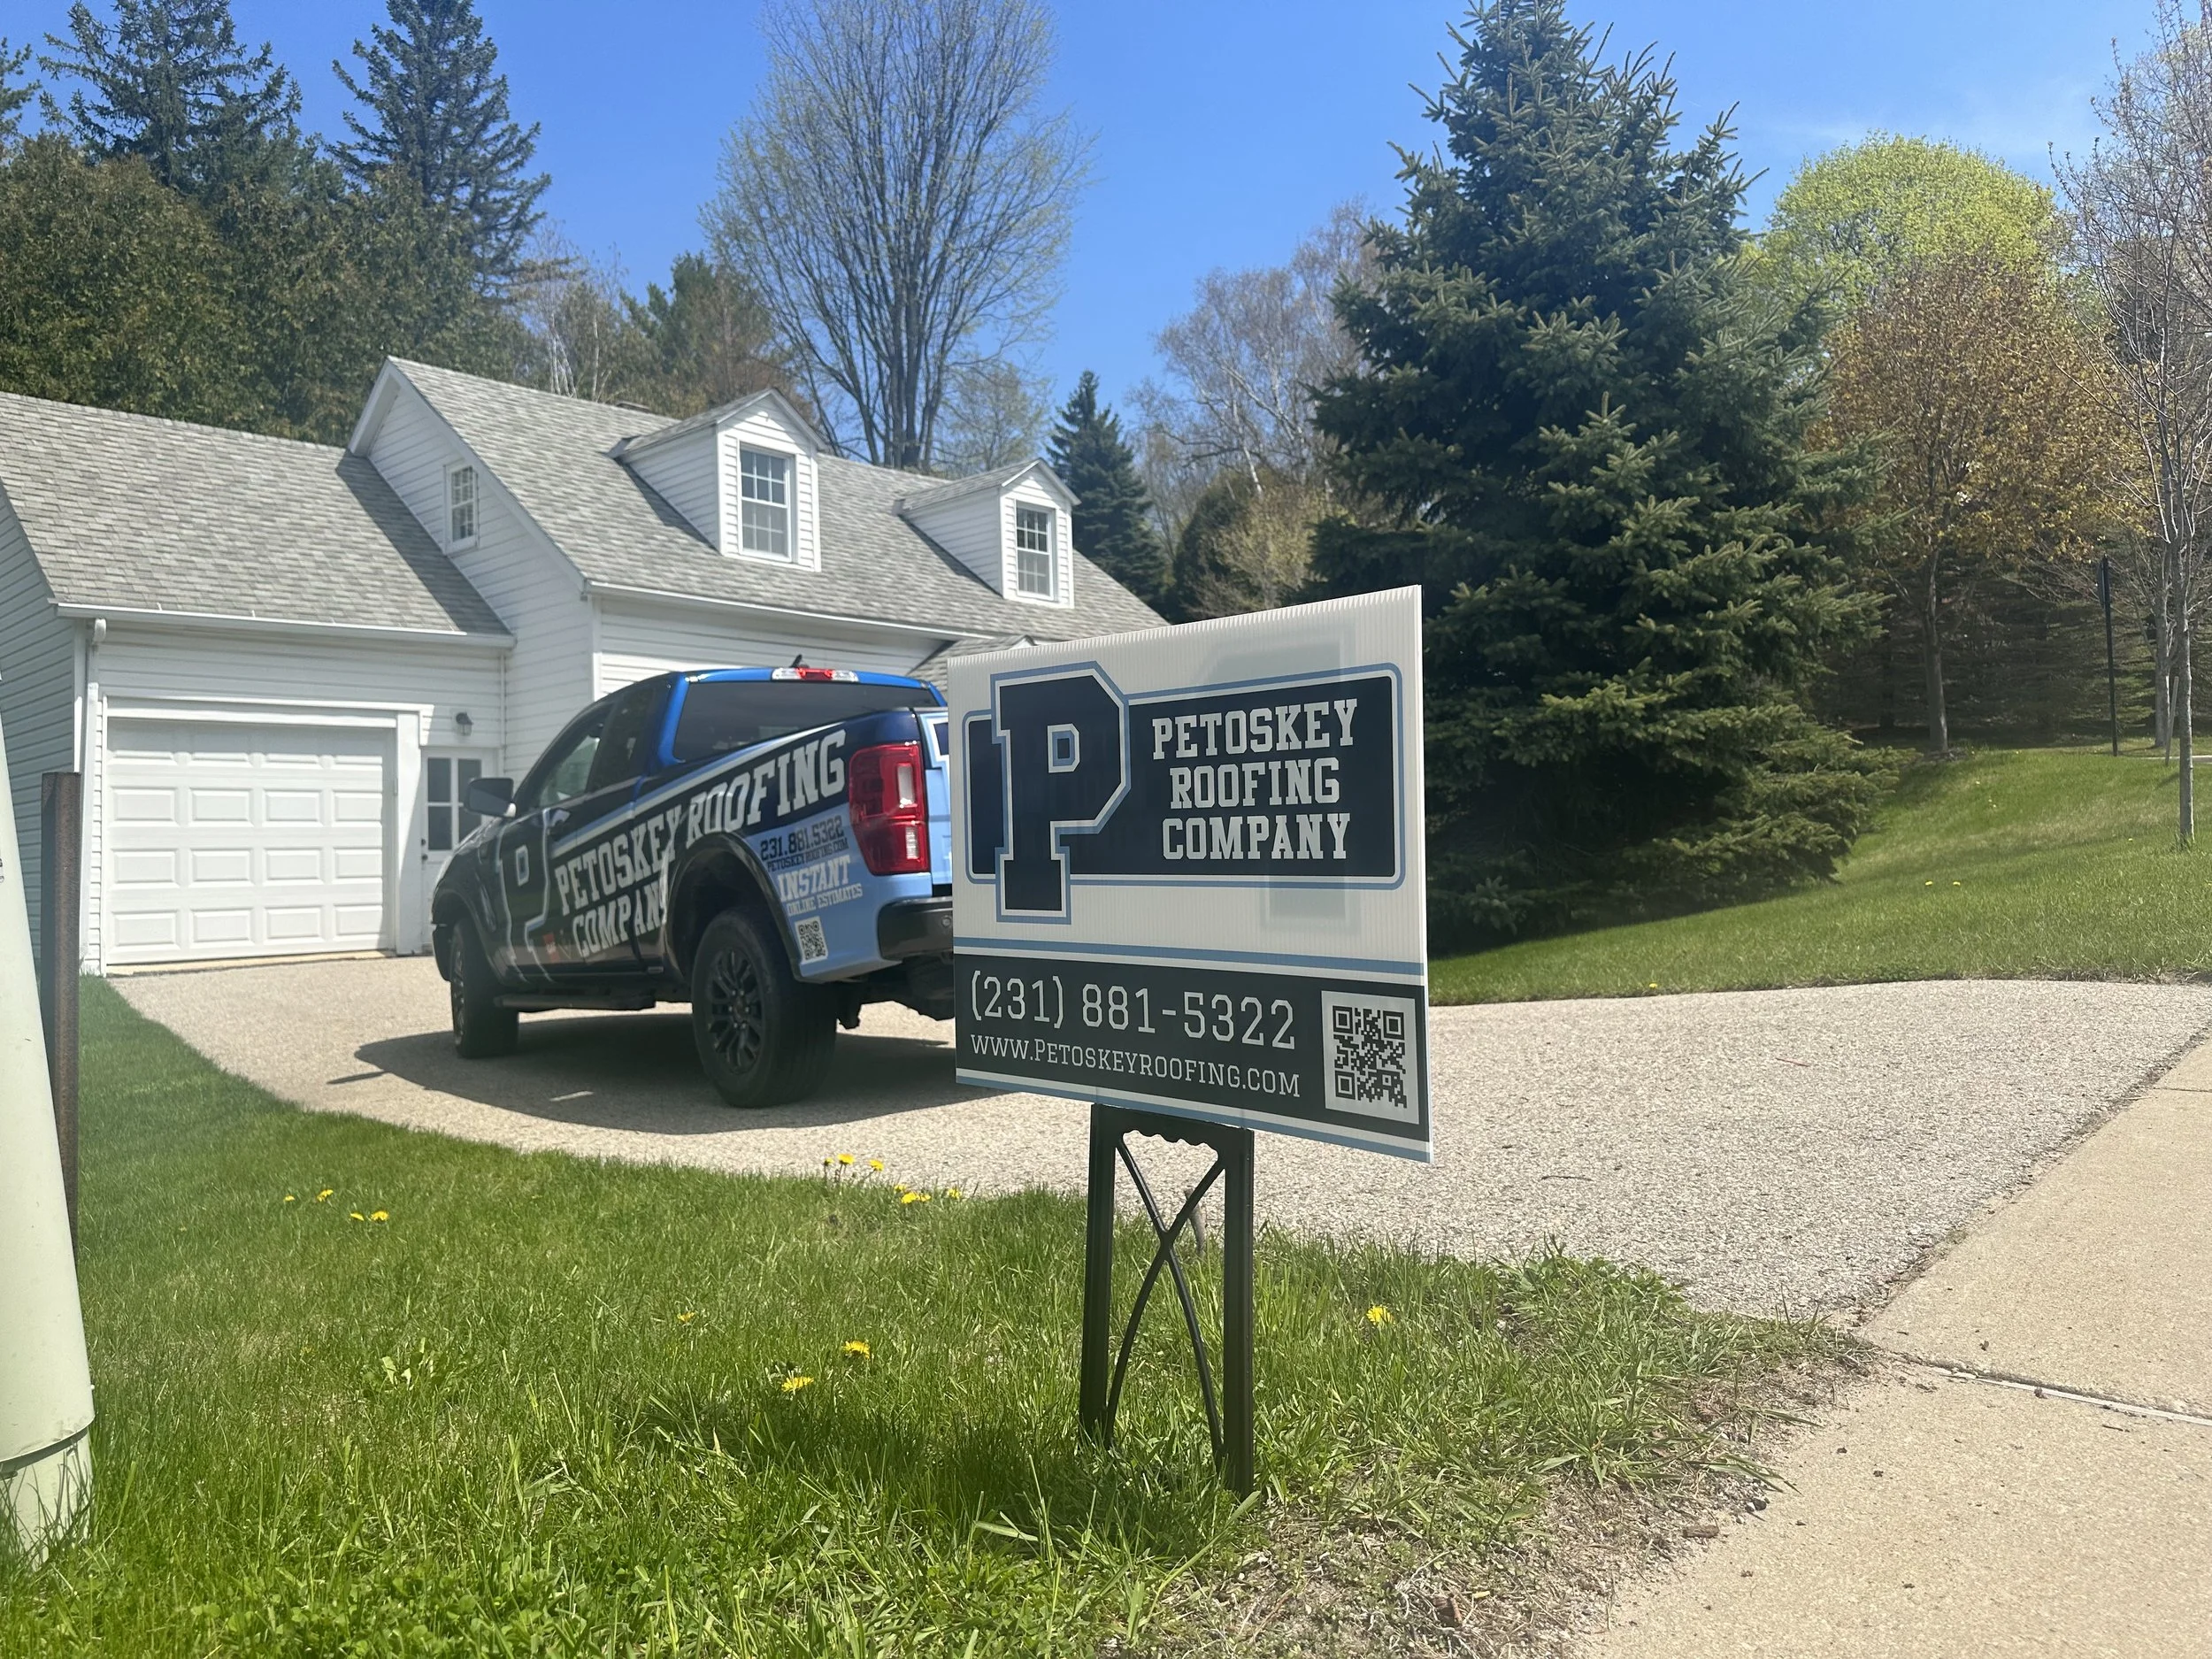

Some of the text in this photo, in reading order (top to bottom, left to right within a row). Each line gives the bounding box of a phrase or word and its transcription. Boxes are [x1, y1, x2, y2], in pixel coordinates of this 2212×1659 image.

[1152, 698, 1357, 760] PETOSKEY
[993, 665, 1128, 920] P
[1170, 757, 1340, 810] ROOFING
[555, 729, 846, 916] PETOSKEY ROOFING
[761, 815, 844, 861] 231.881.5322
[1163, 813, 1350, 860] COMPANY
[778, 855, 850, 902] INSTANT
[787, 883, 863, 917] ONLINE ESTIMATES
[972, 970, 1295, 1049] (231) 881-5322
